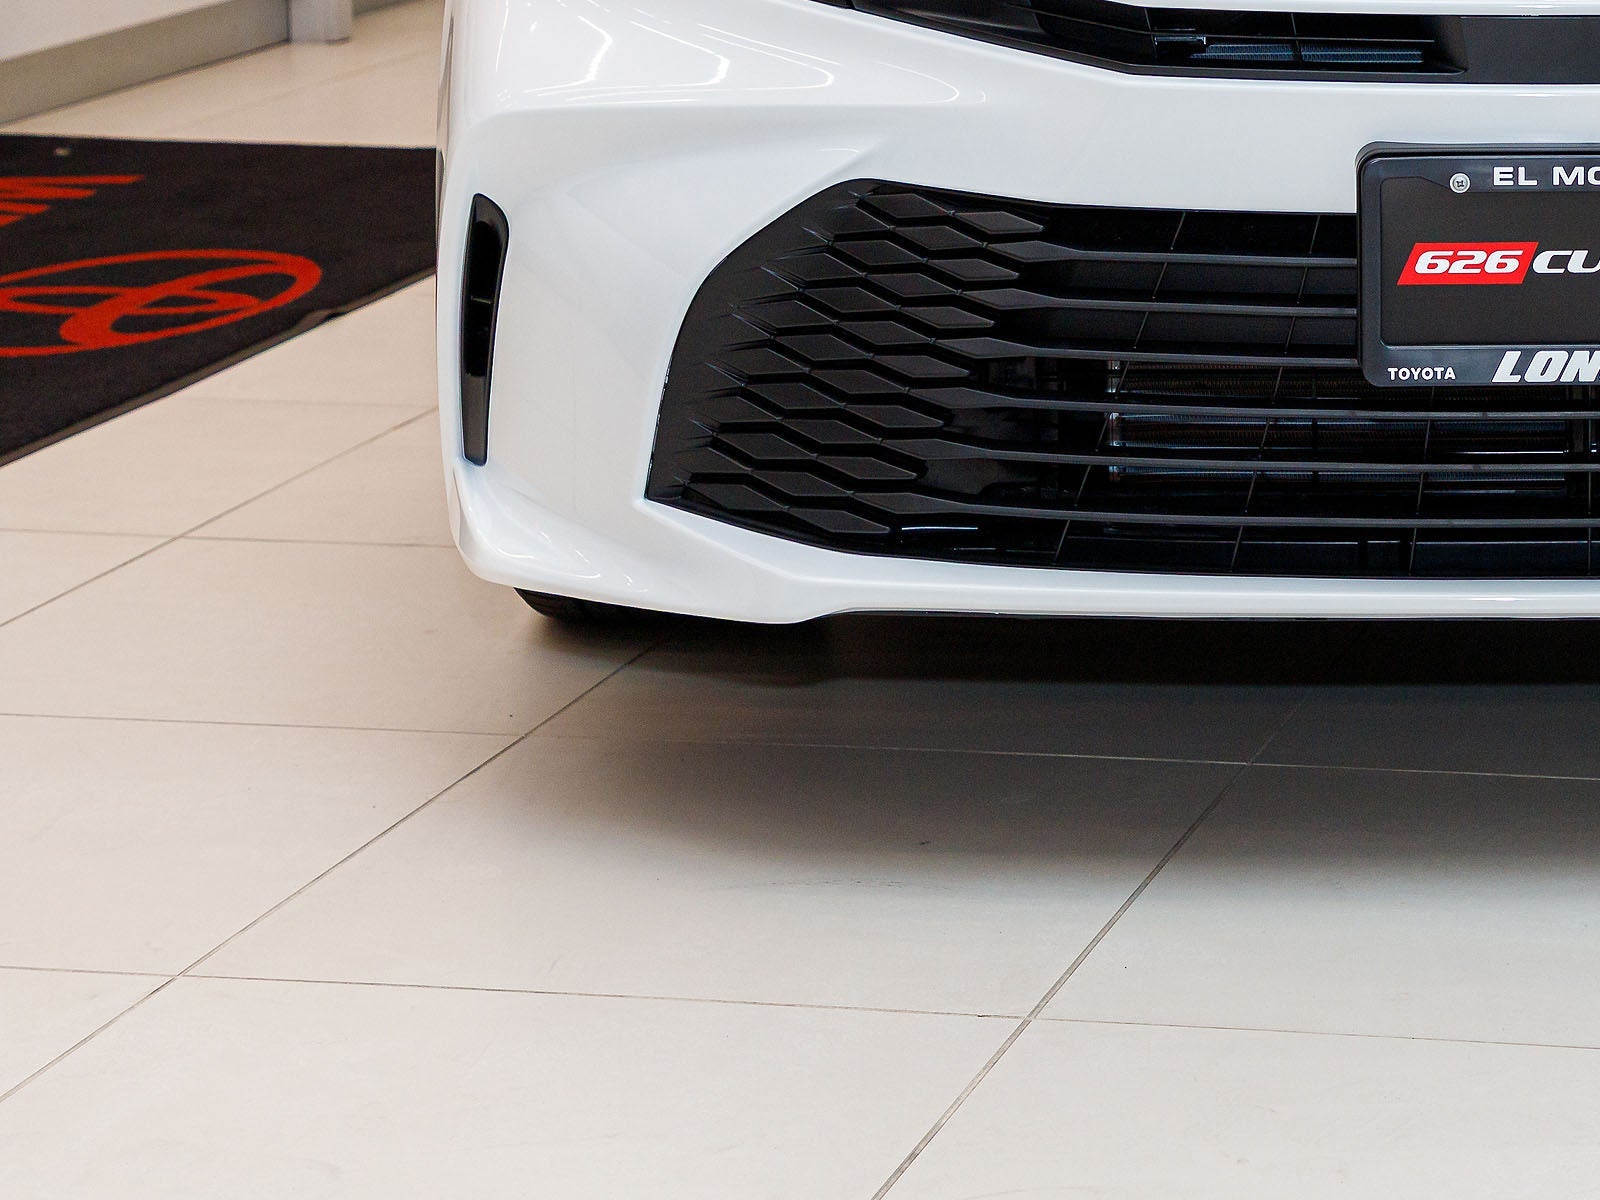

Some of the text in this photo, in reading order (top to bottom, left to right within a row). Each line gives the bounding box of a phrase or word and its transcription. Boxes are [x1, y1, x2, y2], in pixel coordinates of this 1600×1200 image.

[1493, 166, 1538, 186] EL
[1414, 250, 1524, 274] 626
[1387, 366, 1456, 381] TOYOTA
